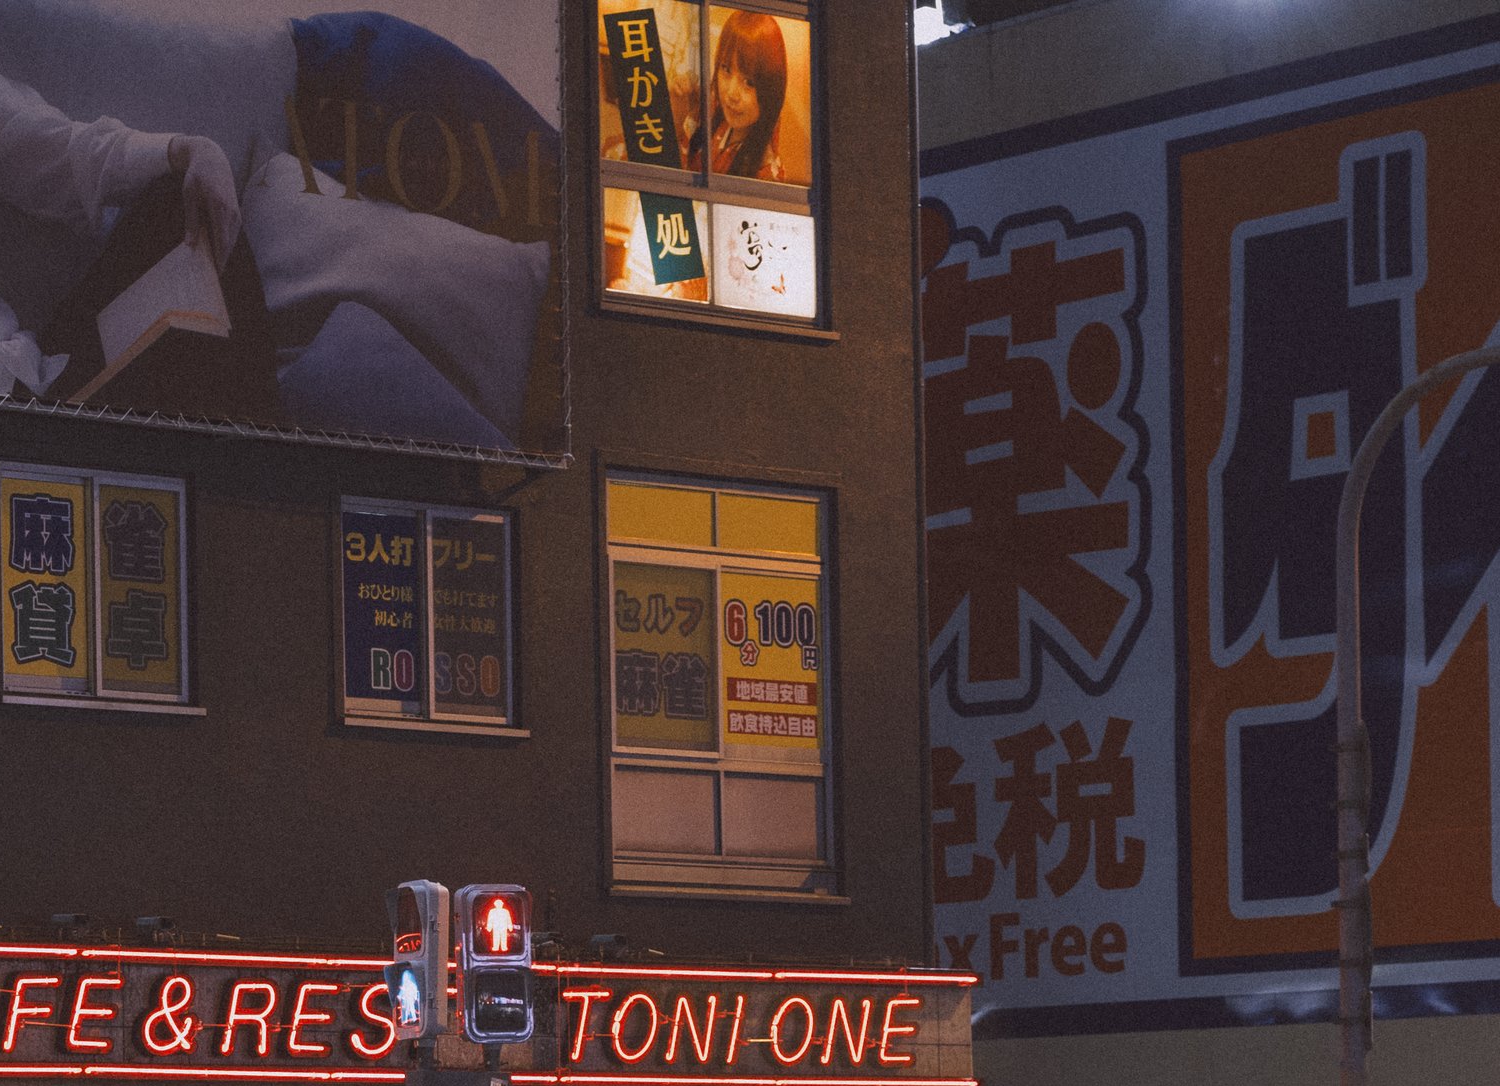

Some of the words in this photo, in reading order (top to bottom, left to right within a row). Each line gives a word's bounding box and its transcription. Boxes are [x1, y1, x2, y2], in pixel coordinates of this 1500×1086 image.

[924, 237, 1133, 685] 薬
[989, 912, 1128, 981] Free
[143, 974, 195, 1054] &
[219, 981, 398, 1058] RES
[770, 995, 921, 1066] ONE
